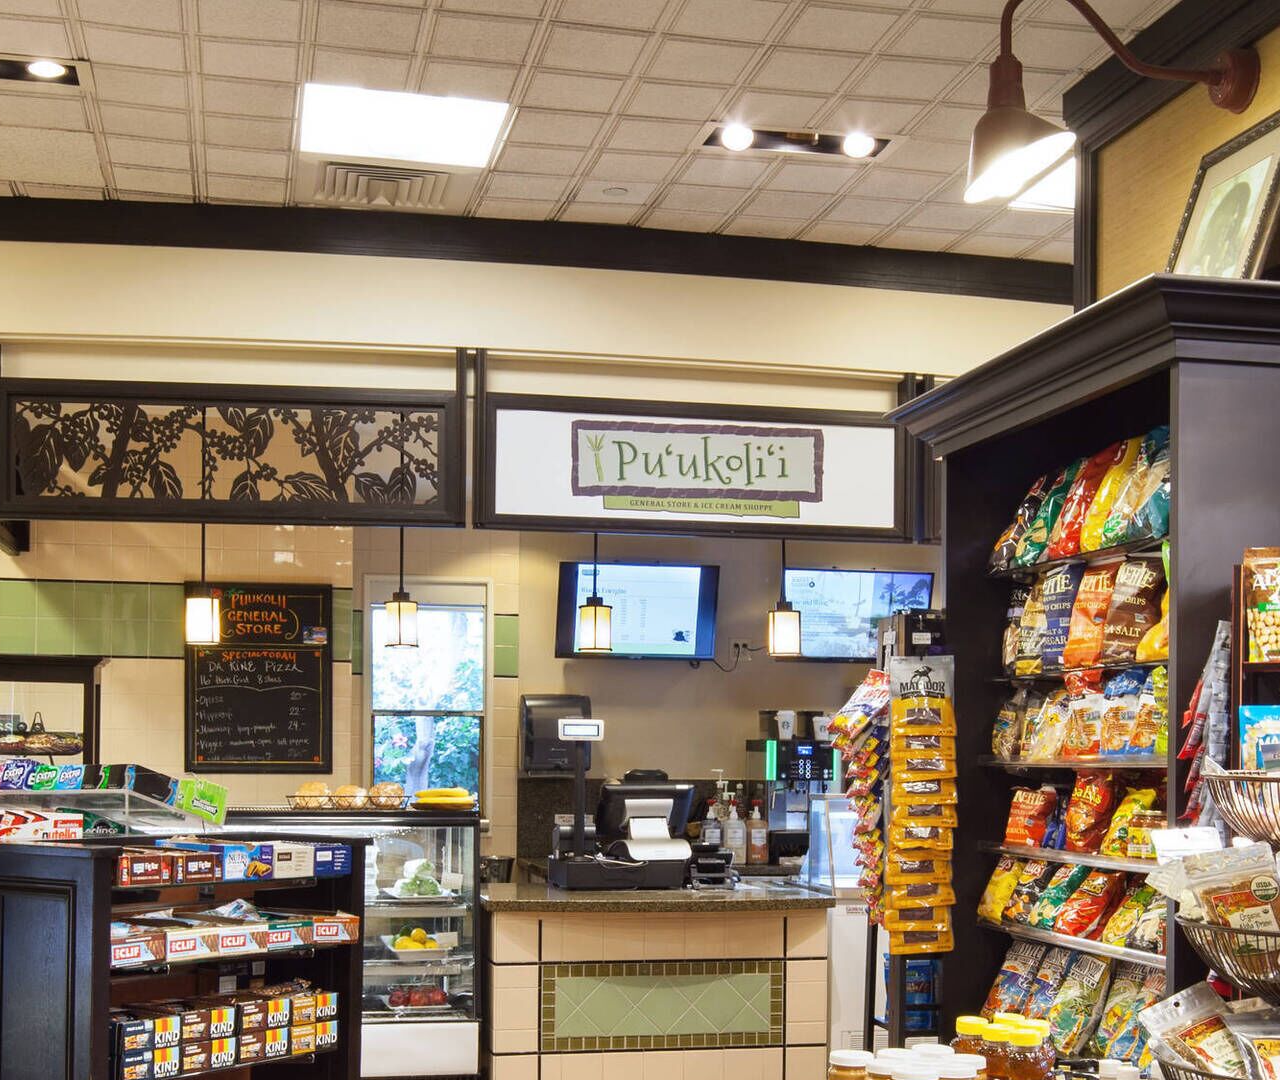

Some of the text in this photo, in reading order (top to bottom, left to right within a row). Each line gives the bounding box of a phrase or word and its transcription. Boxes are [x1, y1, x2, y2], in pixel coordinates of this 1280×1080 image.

[629, 499, 667, 509] GENERAL
[667, 500, 693, 509] STORE
[701, 502, 712, 510] ICE
[715, 503, 742, 511] CREAM
[743, 503, 774, 512] SHOPPE
[227, 610, 288, 623] GENERAL
[235, 623, 283, 635] STORE
[265, 661, 305, 674] PIZZA
[176, 939, 196, 951] CLIF
[120, 946, 141, 960] CLIF
[267, 1011, 289, 1025] KIND
[316, 1005, 337, 1018] KIND
[210, 1022, 234, 1035] KIND
[155, 1031, 180, 1045] KIND
